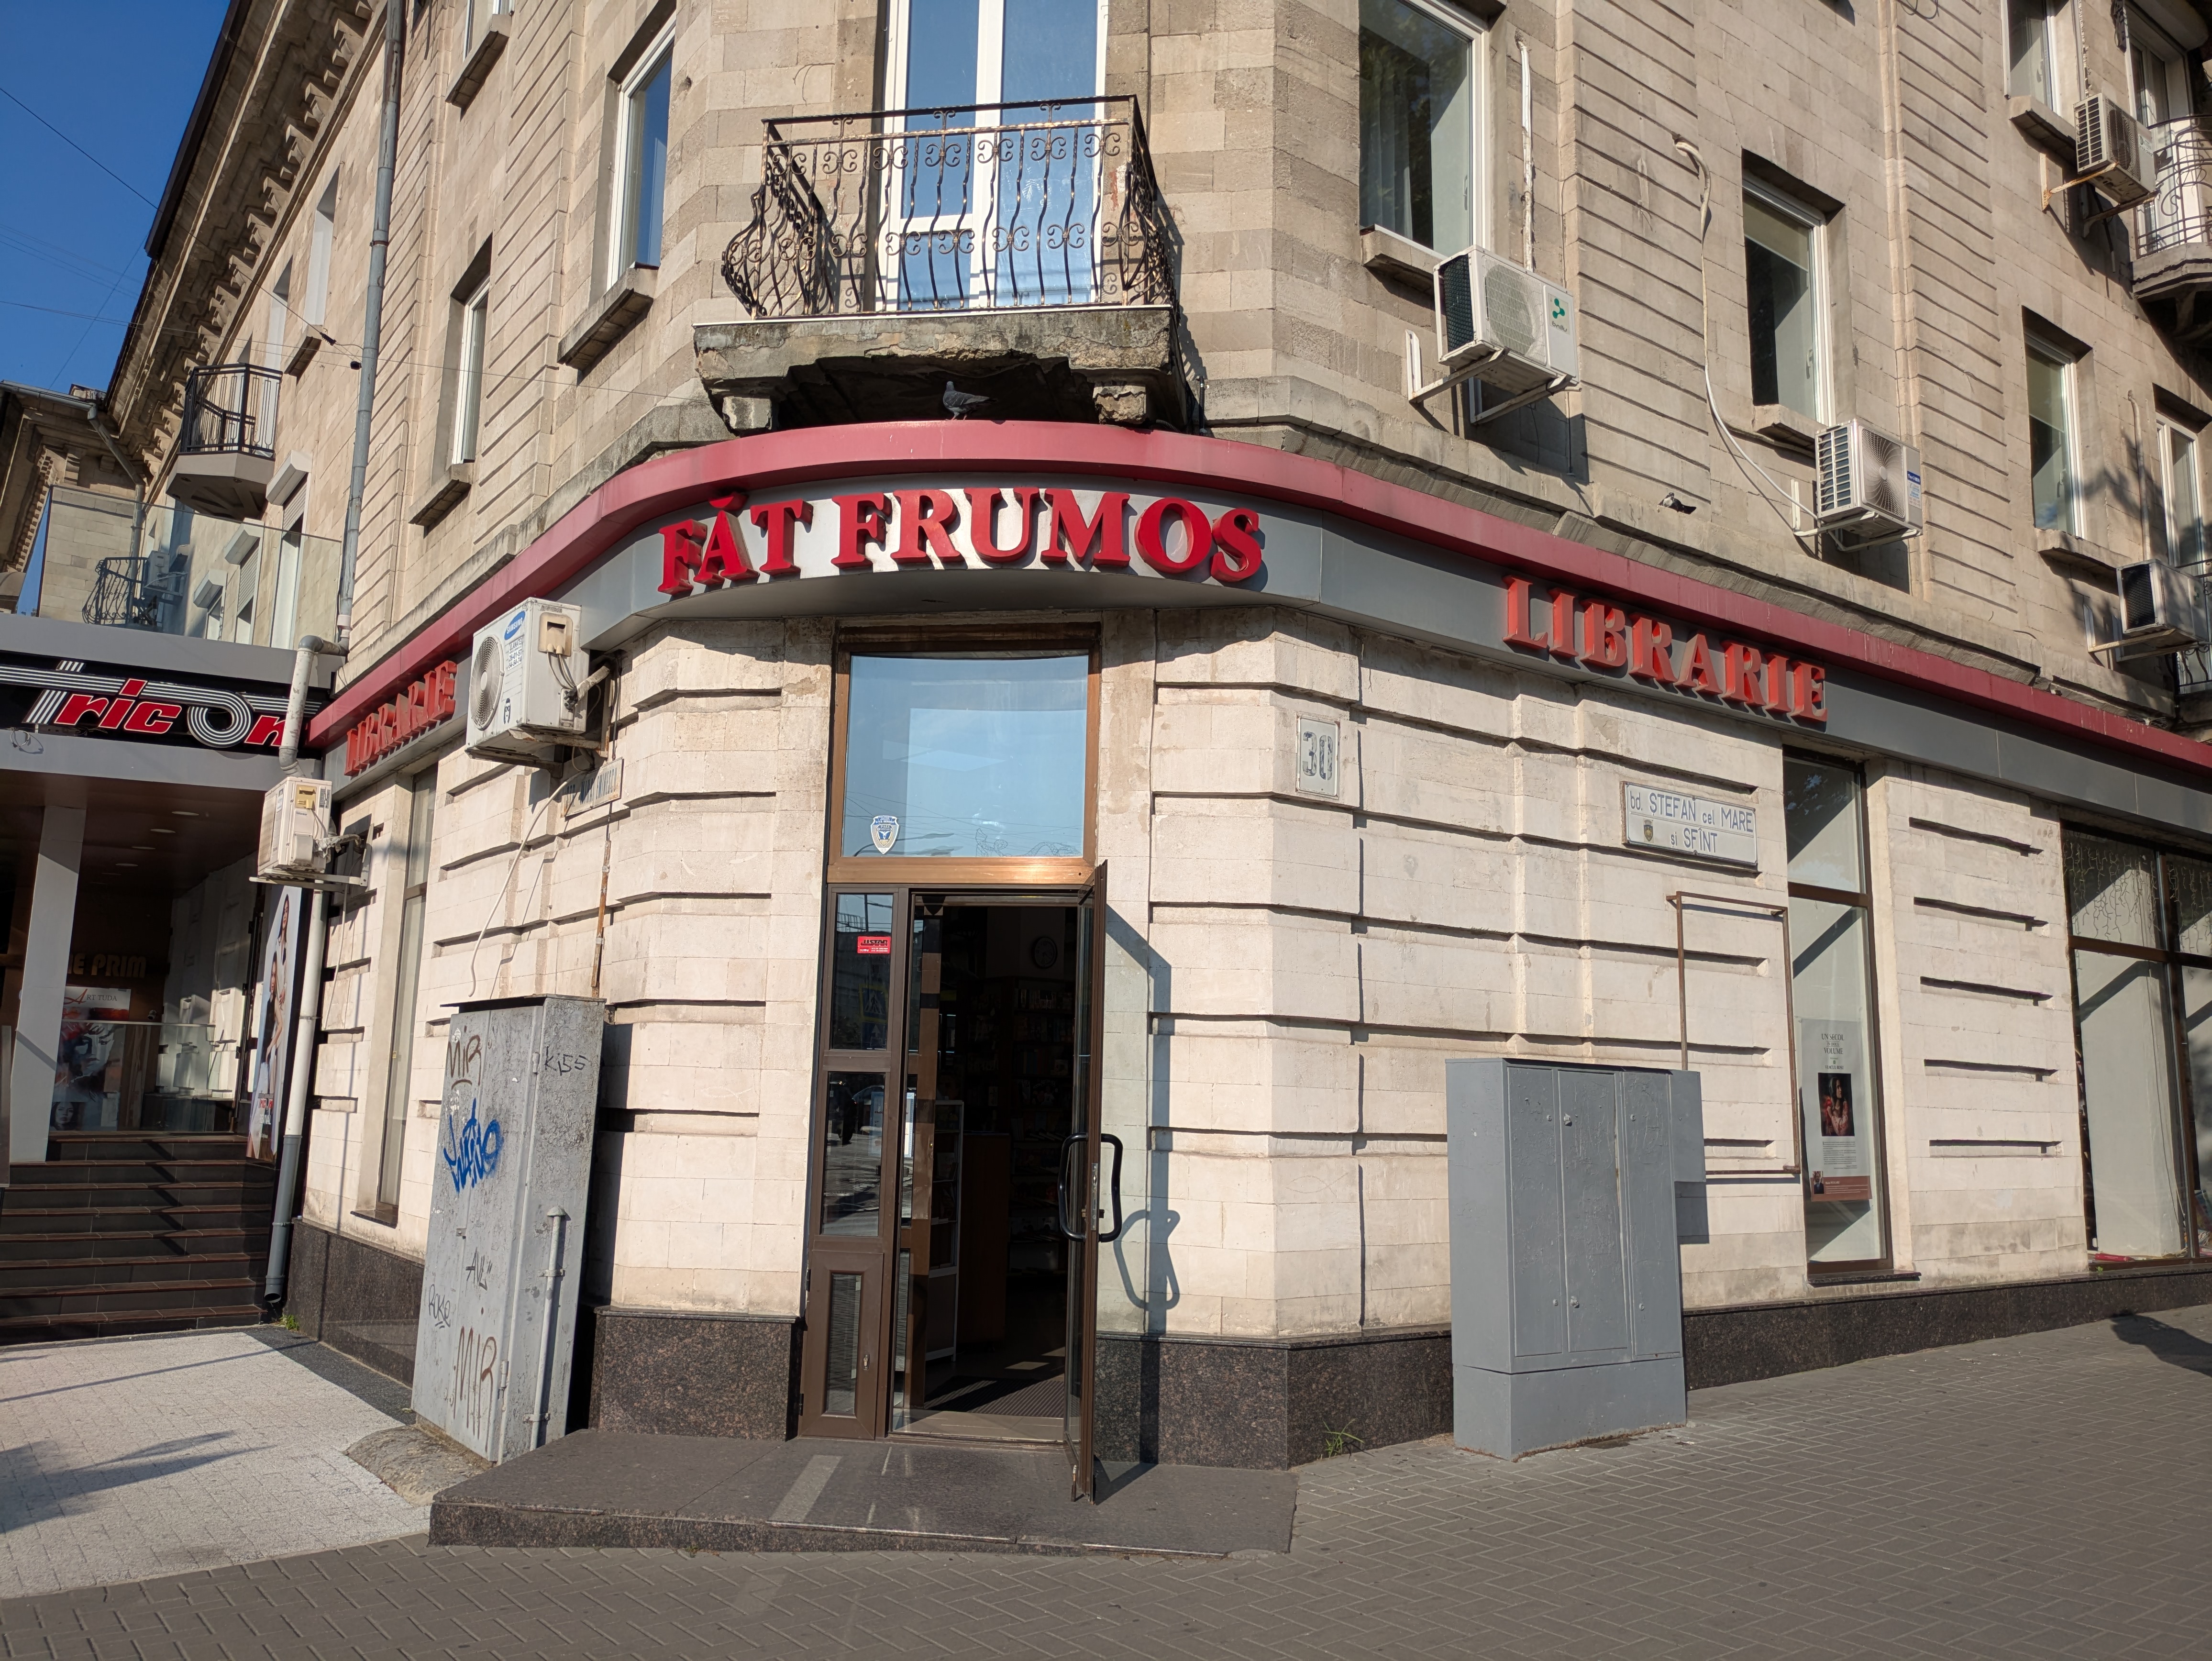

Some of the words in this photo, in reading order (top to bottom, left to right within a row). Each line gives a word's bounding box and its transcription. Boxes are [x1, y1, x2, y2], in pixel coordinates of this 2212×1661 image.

[831, 486, 1262, 583] FRUMOS
[507, 617, 523, 634] SAMSUNG
[1502, 575, 1828, 722] LIBRARIE
[344, 660, 457, 776] LIBRARIE
[1302, 731, 1334, 781] 30
[1629, 790, 1643, 811] bd.
[1702, 809, 1715, 825] cel
[1721, 807, 1754, 833] MARE
[1683, 827, 1718, 853] SFÎNT
